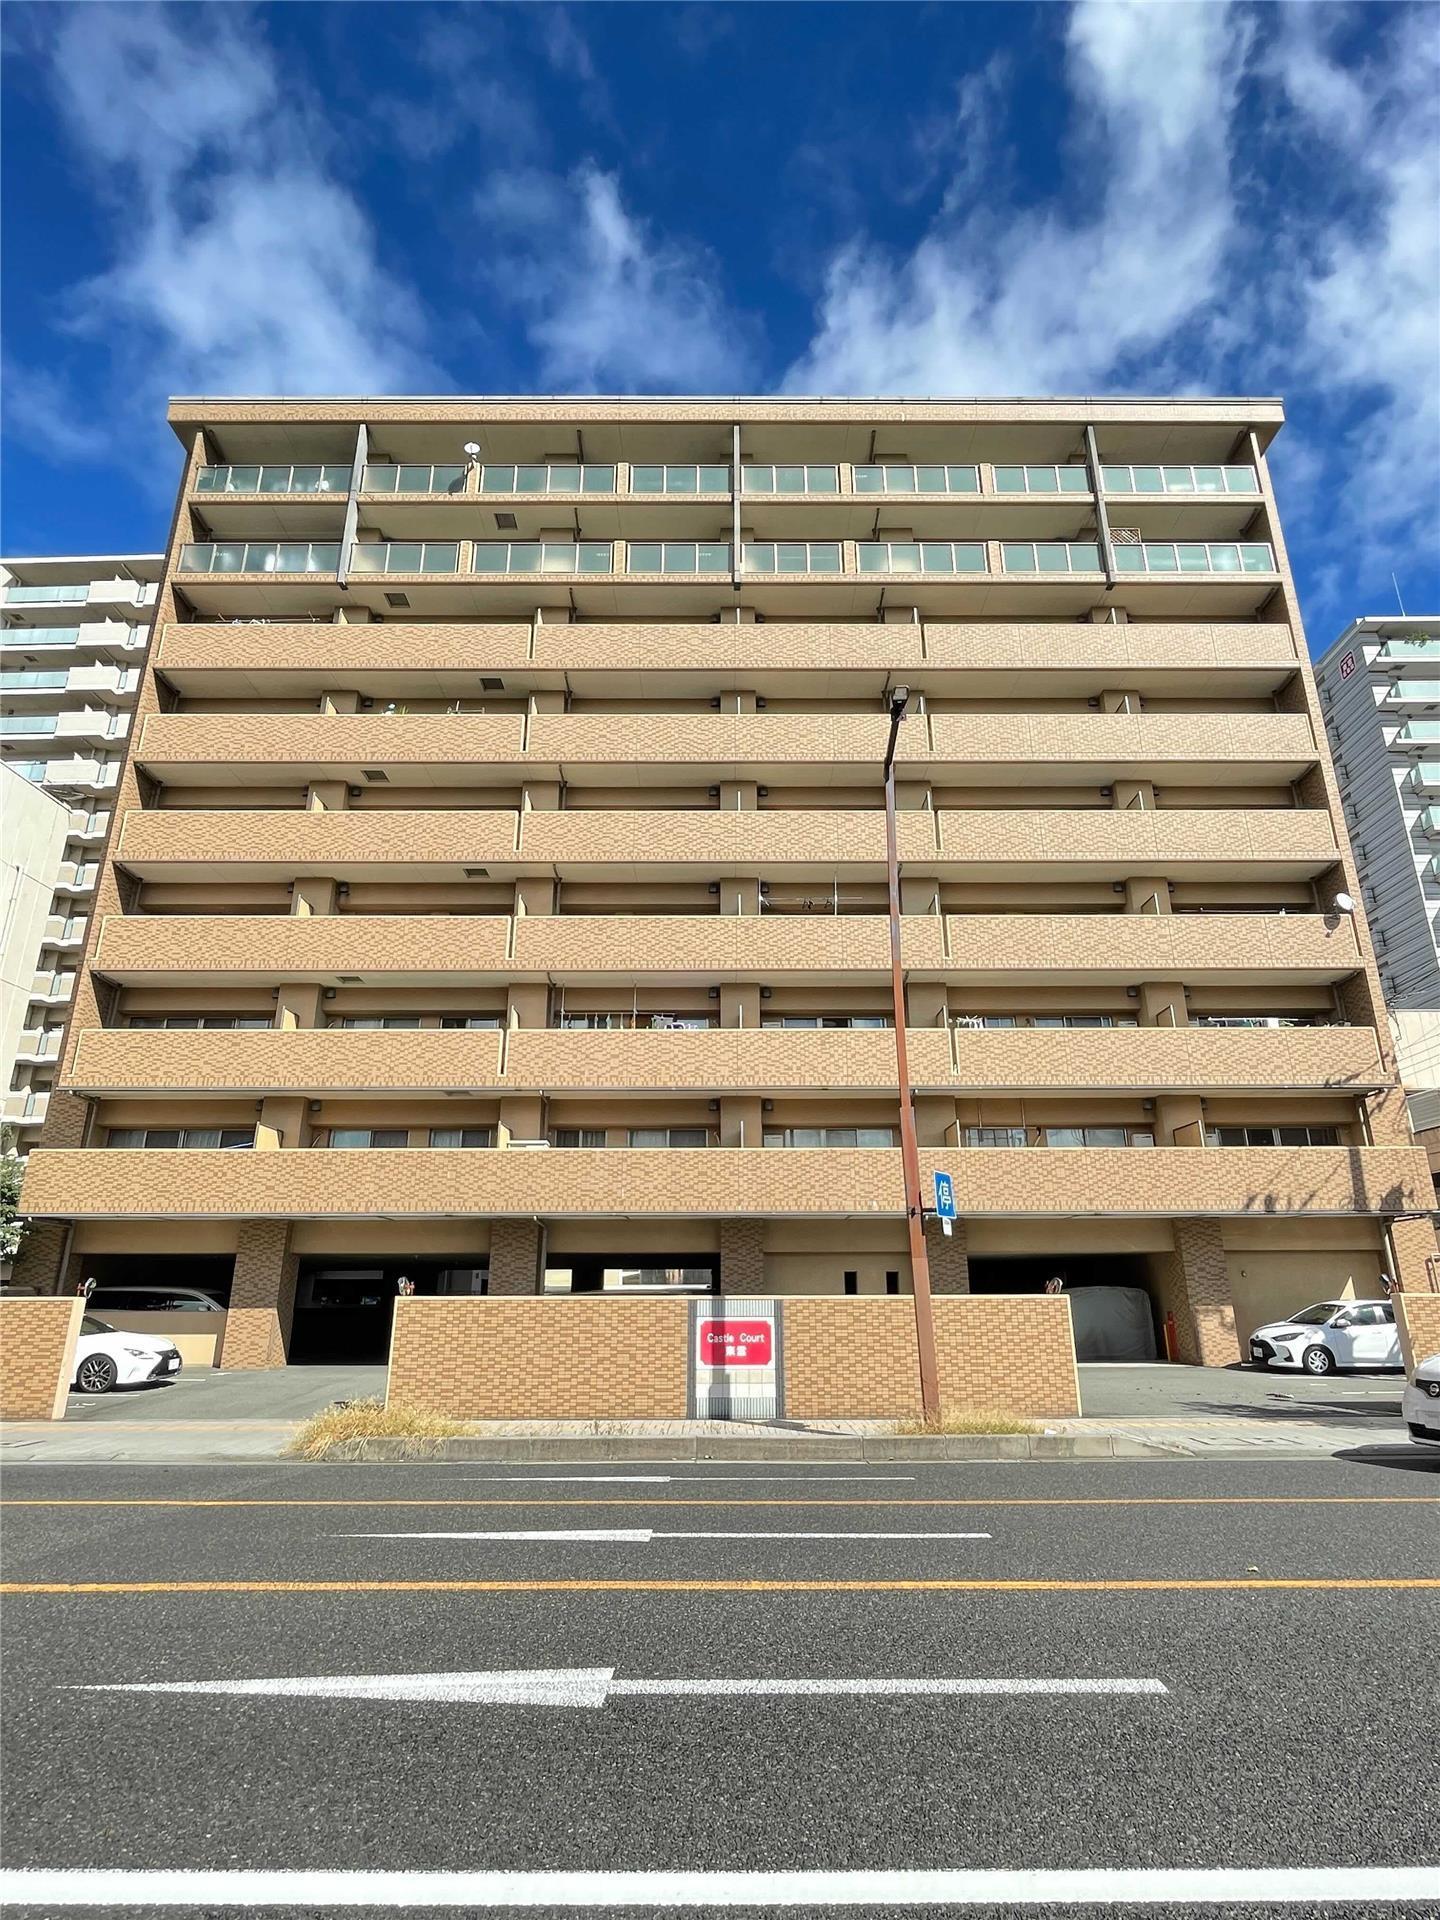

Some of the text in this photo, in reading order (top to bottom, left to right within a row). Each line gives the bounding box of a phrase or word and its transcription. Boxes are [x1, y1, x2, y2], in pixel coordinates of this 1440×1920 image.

[938, 1180, 951, 1210] 停
[707, 1333, 765, 1343] Castle Court
